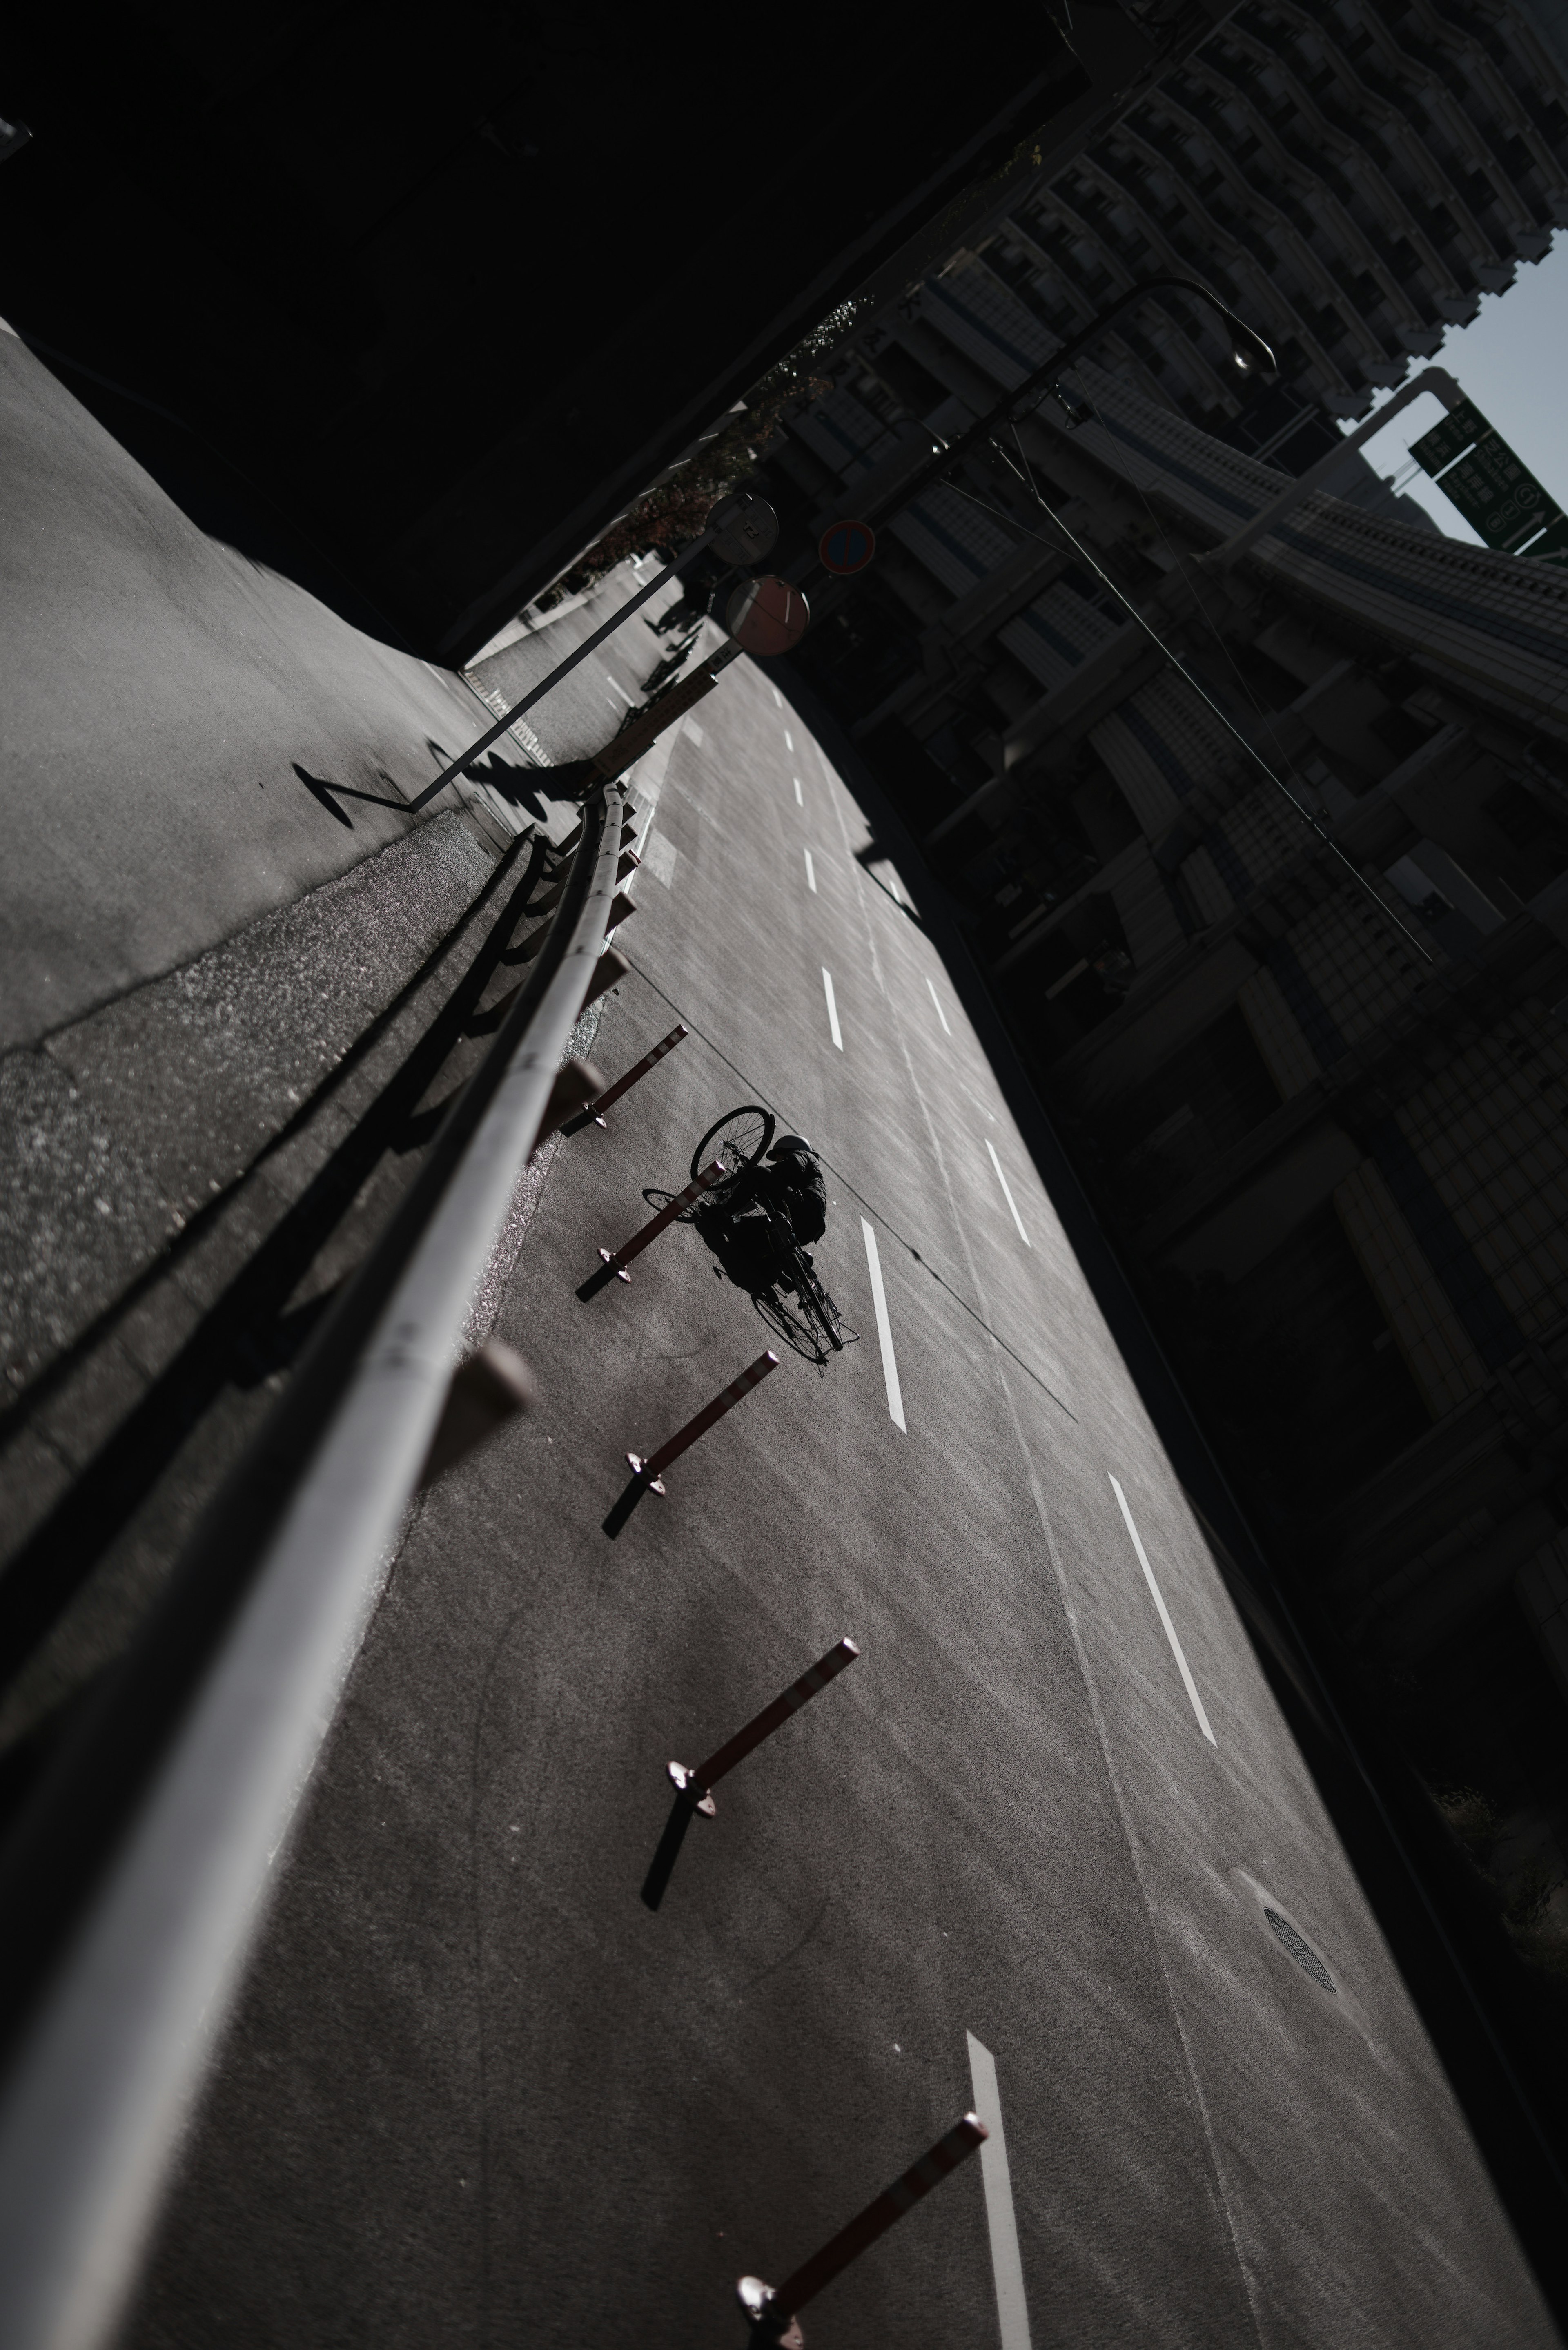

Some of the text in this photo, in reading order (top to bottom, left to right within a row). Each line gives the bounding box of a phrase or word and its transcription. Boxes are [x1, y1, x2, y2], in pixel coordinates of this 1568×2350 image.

[1444, 417, 1464, 441] Ueno
[1452, 410, 1477, 434] 上野
[1426, 430, 1451, 458] 横浜
[1474, 449, 1509, 492] Shibakoen
[1483, 438, 1521, 482] 芝公園
[1457, 461, 1494, 503] 湾岸線
[1520, 487, 1535, 504] C1
[1504, 506, 1514, 516] 1
